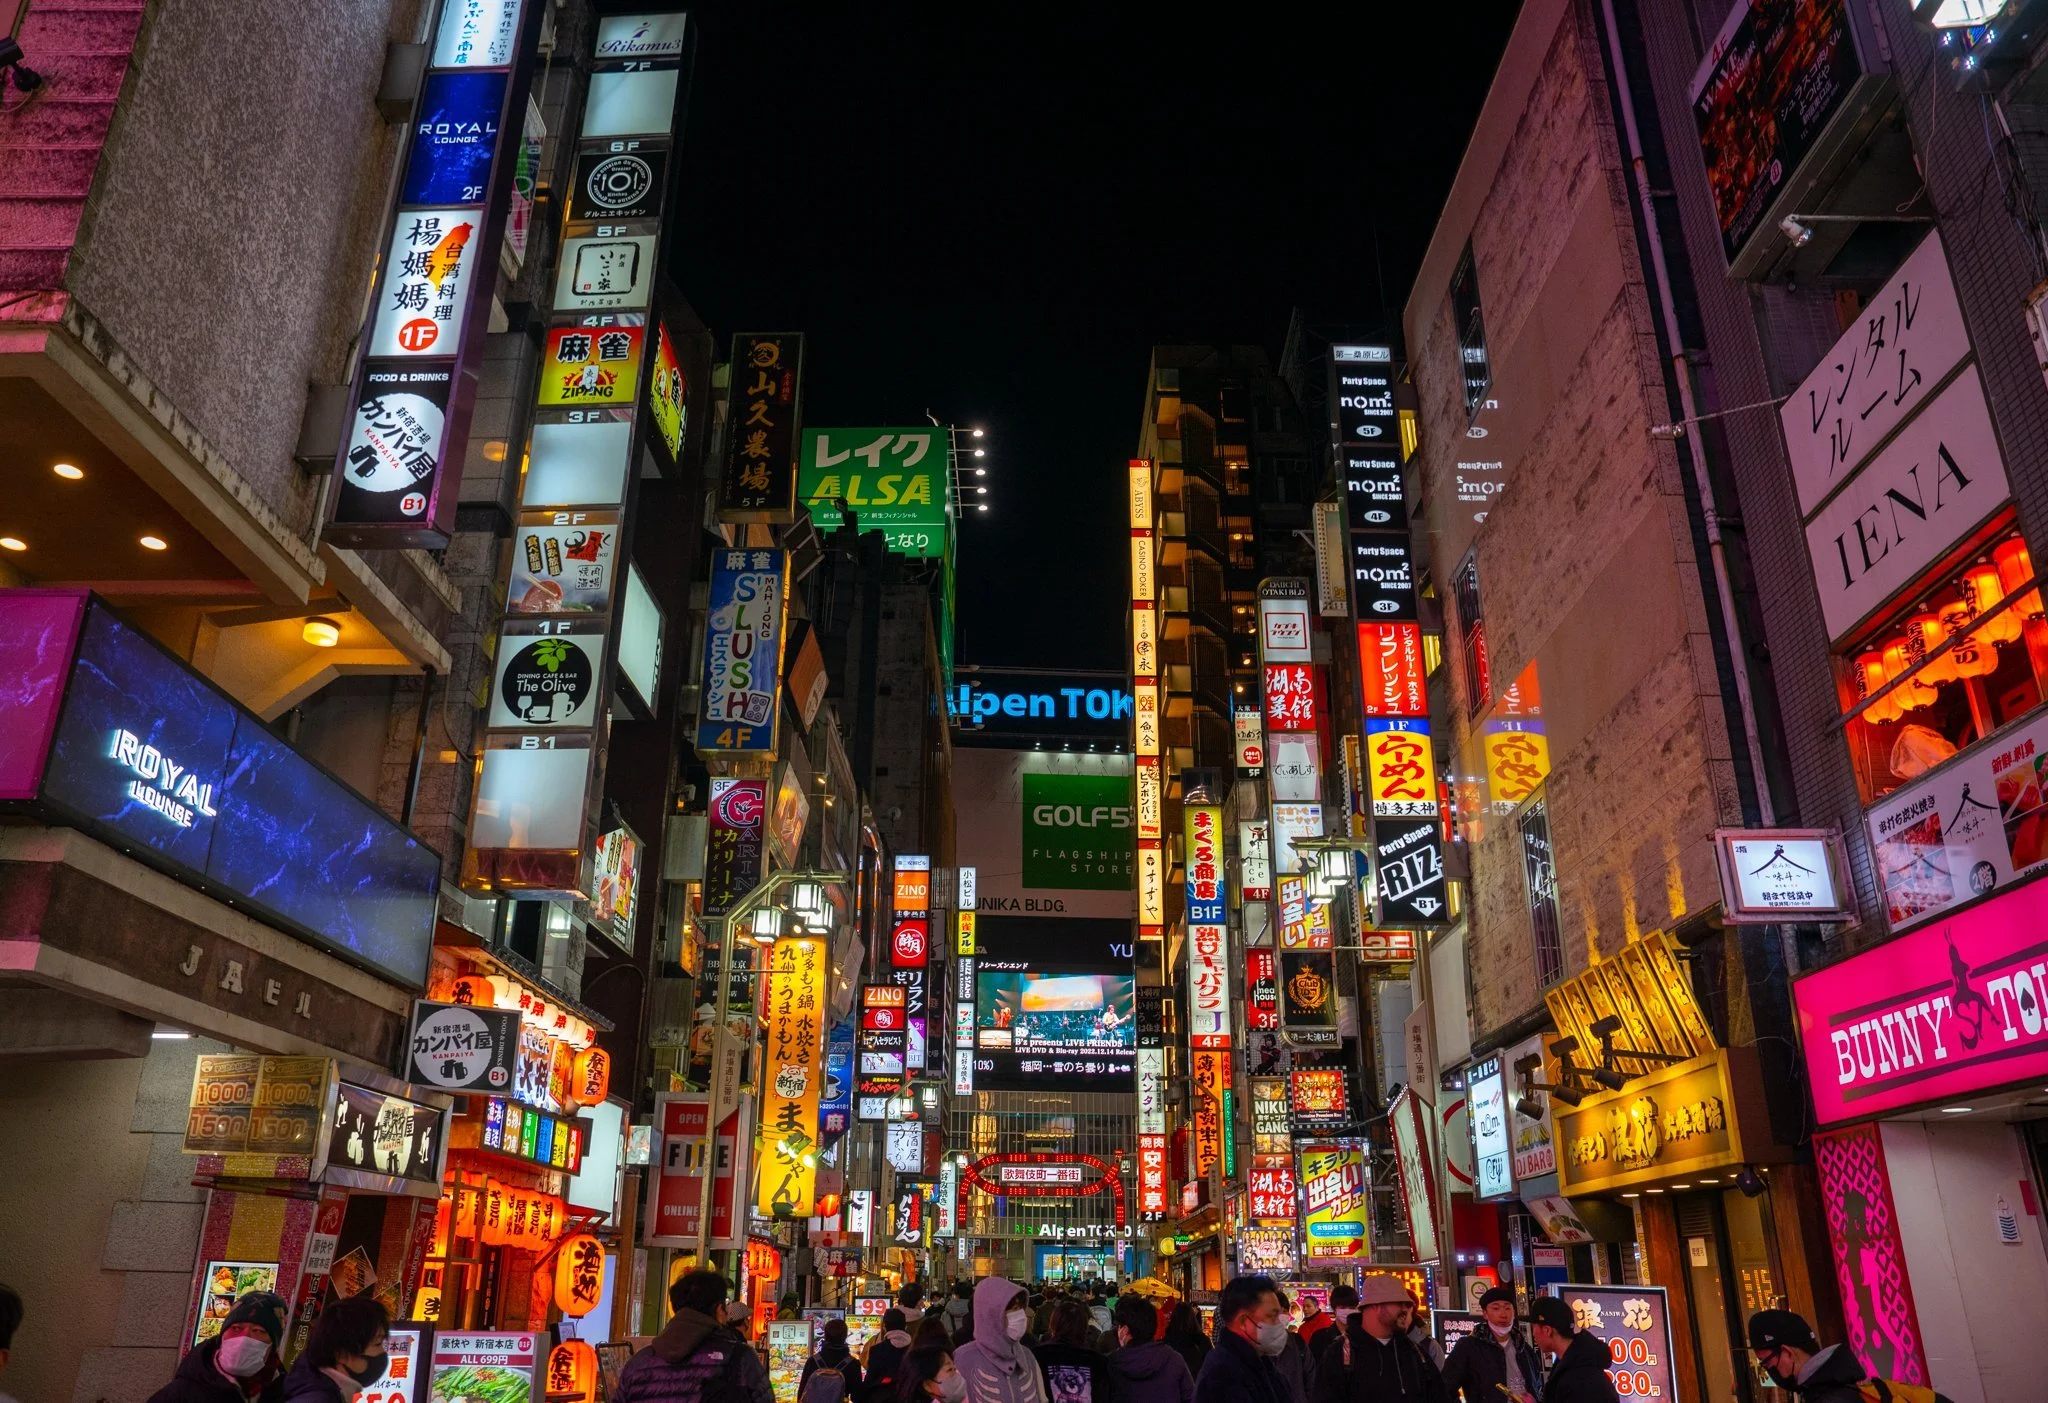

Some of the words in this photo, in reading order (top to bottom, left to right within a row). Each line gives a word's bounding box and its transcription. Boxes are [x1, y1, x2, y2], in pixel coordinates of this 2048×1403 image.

[1711, 35, 1727, 66] 4F
[623, 62, 651, 72] 7F
[420, 122, 496, 135] ROYAL
[434, 136, 478, 144] LOUNGE
[610, 141, 639, 152] 6F
[461, 186, 482, 200] 2F
[597, 226, 627, 237] 5F
[392, 217, 442, 312] 楊媽媽
[433, 242, 464, 322] 台湾料理
[583, 316, 613, 327] 4F
[402, 325, 437, 347] 1F
[557, 332, 632, 362] 麻雀
[1809, 280, 1921, 436] レンタル
[369, 374, 399, 382] FOOD
[410, 373, 449, 381] DRINKS
[1342, 377, 1362, 386] Party
[1363, 377, 1387, 386] Space
[569, 411, 600, 422] 3F
[1829, 349, 1922, 478] ルーム
[396, 407, 432, 446] 新宿酒場
[360, 398, 437, 482] カンパイ屋
[364, 428, 400, 470] KANPAIYA
[816, 435, 930, 467] レイク
[1350, 460, 1370, 469] Party
[1371, 460, 1395, 469] Space
[808, 475, 930, 505] ALSA
[403, 498, 424, 511] B1
[742, 497, 765, 507] 5F
[1134, 490, 1144, 519] ABYSS
[553, 513, 586, 525] 2F
[1371, 513, 1383, 521] 4F
[1834, 441, 1973, 591] IENA
[1138, 540, 1146, 570] CASINO
[1358, 547, 1378, 556] Party
[1380, 547, 1404, 556] Space
[727, 552, 771, 570] 麻雀
[1380, 603, 1393, 611] 3F
[538, 621, 571, 634] 1F
[1403, 626, 1417, 677] レンタルルーム
[1378, 626, 1402, 714] リフレッシュ
[517, 680, 538, 692] The
[541, 679, 576, 692] Olive
[1267, 668, 1312, 695] 湖南
[1408, 682, 1421, 710] ホステル
[1268, 696, 1313, 720] 菜館
[1367, 705, 1378, 713] 2F
[1284, 720, 1300, 728] 4F
[1388, 721, 1409, 731] 1F
[716, 728, 752, 748] 4F
[1140, 721, 1155, 747] 魚金
[521, 736, 556, 749] B1
[111, 729, 217, 817] ROYAL
[1249, 769, 1260, 777] 5F
[714, 782, 731, 791] 3F
[129, 780, 195, 828] LOUNGE
[1374, 802, 1435, 816] 博多天神
[1879, 795, 1936, 836] 串打ち炭火焼き
[1379, 837, 1405, 857] Party
[1403, 824, 1434, 845] Space
[1033, 849, 1131, 860] FLAGSHIP
[1194, 811, 1218, 901] まぐろ商店
[719, 829, 737, 906] カリーナ
[1071, 864, 1132, 874] STORE
[1972, 863, 1996, 890] 2階
[897, 885, 927, 896] ZINO
[963, 871, 972, 907] 小松ビル
[1253, 889, 1269, 899] 4F
[1025, 899, 1068, 912] BLDG.
[1418, 900, 1435, 908] B1
[1192, 907, 1222, 919] B1F
[1281, 881, 1306, 947] 出会い
[1313, 938, 1328, 947] 1F
[1365, 935, 1410, 958] 3F
[797, 944, 816, 1010] 博多もつ鍋
[867, 989, 902, 1001] ZINO
[1258, 1013, 1277, 1028] 3F
[433, 1024, 470, 1034] 新宿酒場
[414, 1031, 493, 1054] カンパイ屋
[796, 1014, 814, 1064] 水炊き
[1030, 1039, 1063, 1047] presents
[1065, 1039, 1085, 1047] LIVE
[1087, 1040, 1122, 1048] FRIENDS
[1201, 1037, 1221, 1047] 4F
[432, 1051, 475, 1060] KANPAIYA
[491, 1071, 505, 1081] B1
[198, 1082, 248, 1105] 1000
[1255, 1101, 1287, 1114] NIKU
[190, 1114, 247, 1137] 1500
[679, 1114, 704, 1124] OPEN
[1256, 1121, 1289, 1133] GANG
[1140, 1137, 1164, 1149] 焼肉
[1265, 1157, 1284, 1168] 2F
[1308, 1150, 1350, 1175] キラリ
[1516, 1160, 1526, 1176] DJ
[1527, 1152, 1547, 1173] BAR
[1003, 1169, 1080, 1181] 歌舞伎町一番街
[1252, 1171, 1294, 1193] 湖南
[1307, 1162, 1360, 1210] 出会い
[1330, 1191, 1364, 1220] カフェ
[1145, 1211, 1163, 1221] 2F
[441, 1339, 470, 1349] 豪快や
[475, 1339, 514, 1349] 新宿本店
[461, 1356, 478, 1364] ALL
[480, 1355, 508, 1365] 699円
